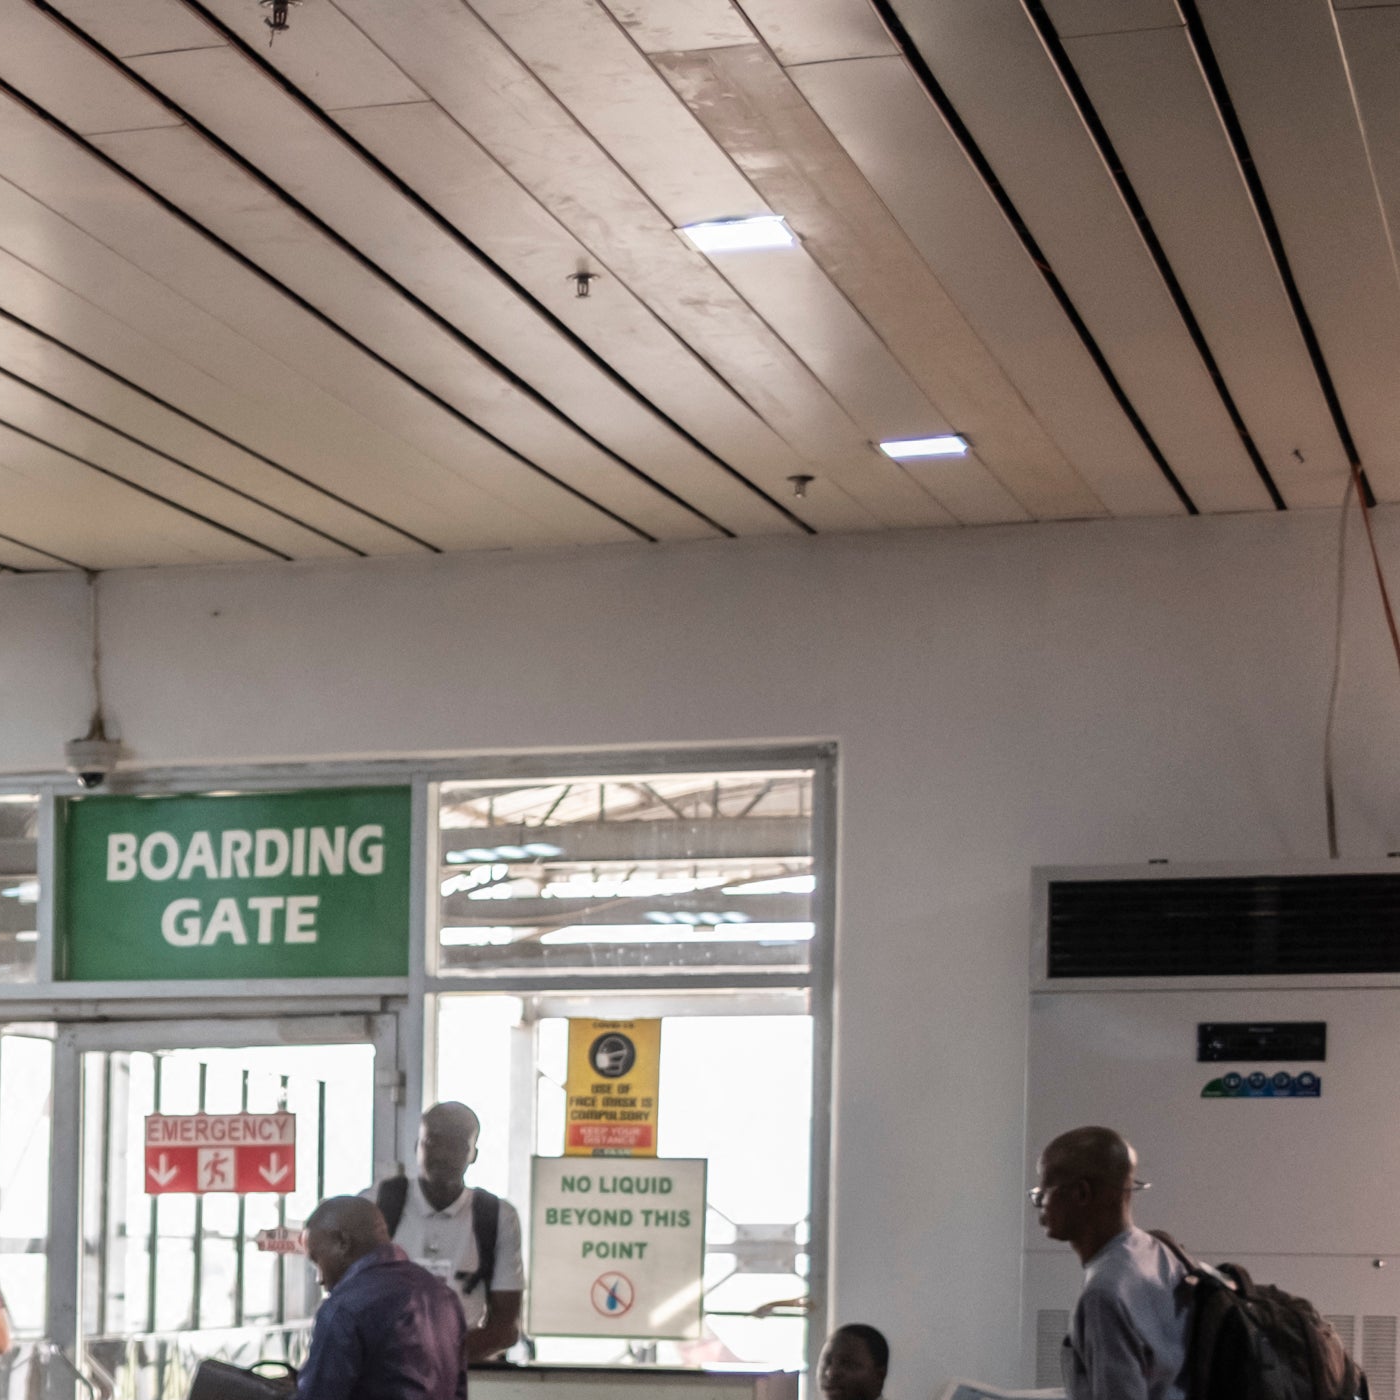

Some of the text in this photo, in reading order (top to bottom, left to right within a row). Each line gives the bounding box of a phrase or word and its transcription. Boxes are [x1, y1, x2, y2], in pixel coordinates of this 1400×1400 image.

[106, 824, 385, 882] BOARDING
[161, 896, 319, 947] GATE
[591, 1084, 631, 1094] USE OF
[570, 1096, 653, 1108] FACE MASK IS
[571, 1110, 650, 1121] COMPULSORY
[149, 1118, 289, 1142] EMERGENCY
[580, 1126, 641, 1135] KEEP YOUR
[583, 1135, 636, 1145] DISTANCE
[561, 1175, 673, 1195] NO LIQUID
[545, 1208, 691, 1228] BEYOND THIS
[582, 1241, 648, 1260] POINT
